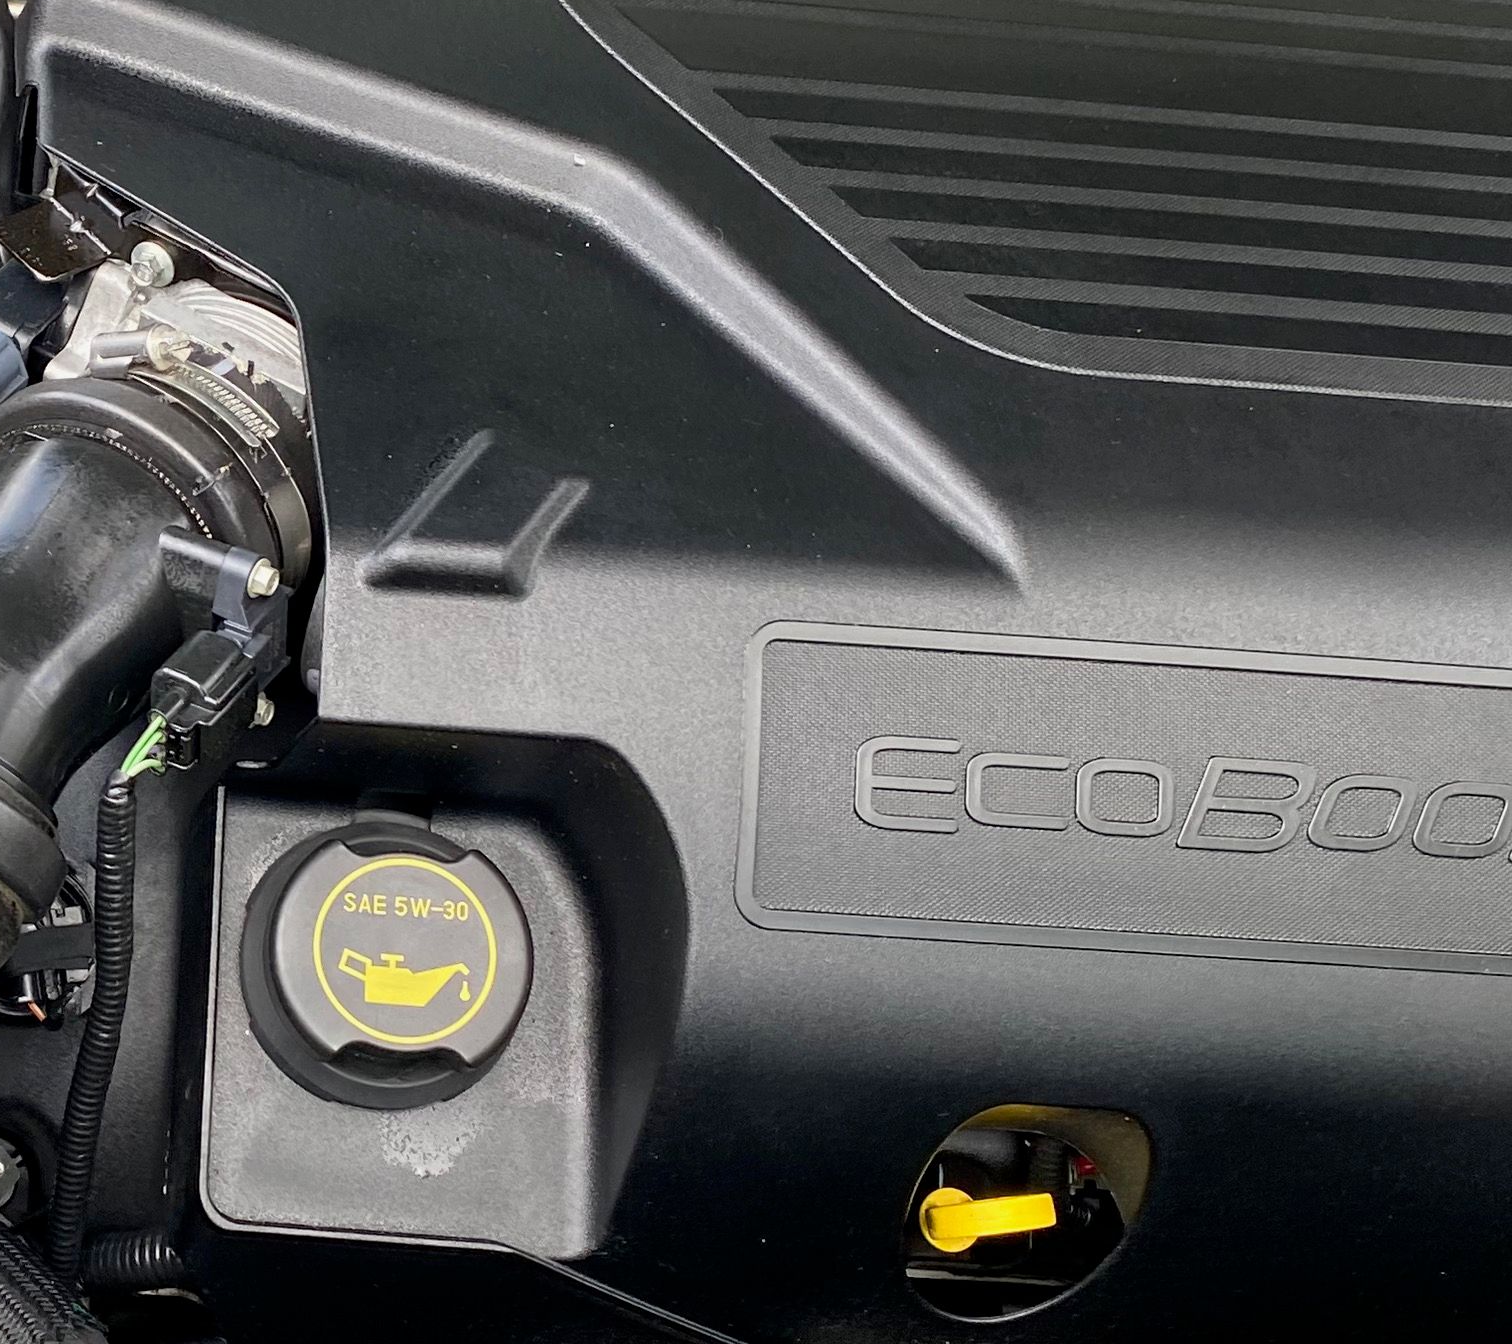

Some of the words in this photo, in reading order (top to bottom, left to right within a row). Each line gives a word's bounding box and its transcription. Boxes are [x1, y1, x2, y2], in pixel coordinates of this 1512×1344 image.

[854, 734, 1512, 859] ECOBOO
[343, 892, 387, 916] SAE
[394, 895, 469, 921] 5W-30
